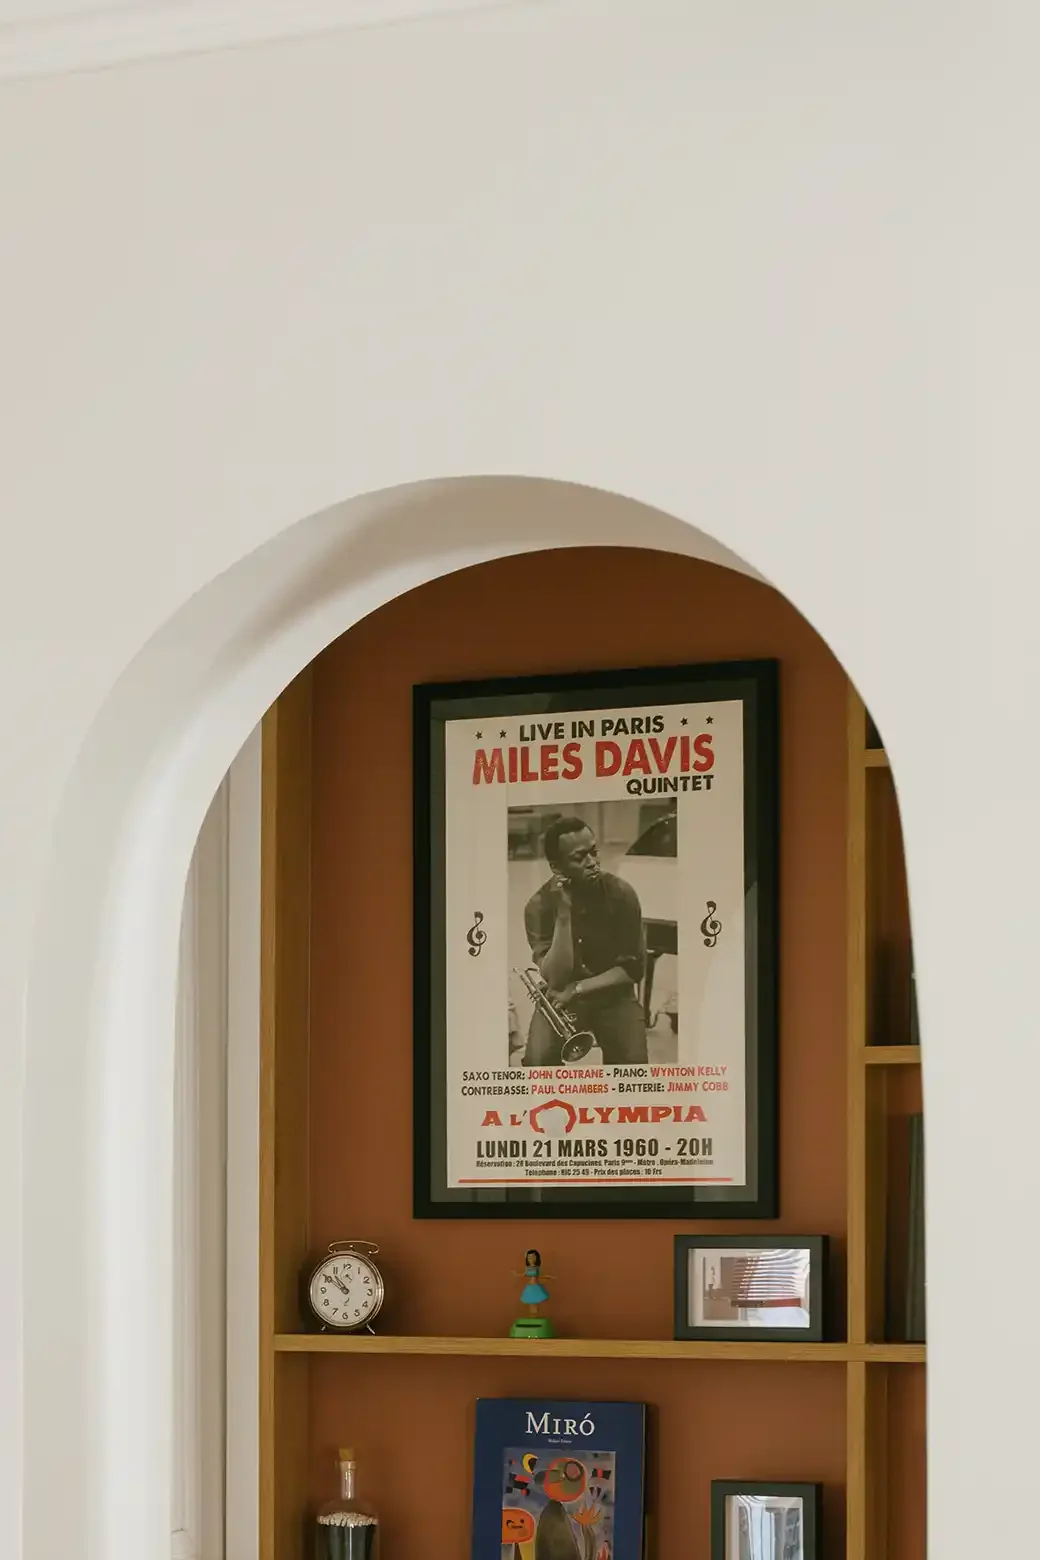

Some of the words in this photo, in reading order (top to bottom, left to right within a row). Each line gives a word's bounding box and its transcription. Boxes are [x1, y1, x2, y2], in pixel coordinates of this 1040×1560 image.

[519, 722, 564, 742] LIVE
[572, 720, 594, 739] IN
[602, 715, 665, 737] PARIS
[472, 742, 583, 785] MILES
[595, 734, 715, 777] DAVIS
[626, 775, 714, 795] QUINTET
[462, 1071, 490, 1081] SAXO
[492, 1071, 525, 1081] TENOR:
[528, 1070, 553, 1079] JOHN
[555, 1069, 604, 1079] COLTRANE
[613, 1068, 648, 1078] PIANO:
[650, 1067, 695, 1078] WYNTON
[697, 1066, 727, 1076] KELLY
[461, 1085, 529, 1096] CONTREBASSE:
[531, 1085, 556, 1095] PAUL
[558, 1084, 609, 1094] CHAMBERS
[618, 1083, 665, 1093] BATTERIE:
[667, 1082, 699, 1092] JIMMY
[702, 1081, 729, 1091] COBB
[480, 1110, 503, 1126] A
[476, 1140, 527, 1158] LUNDI
[533, 1140, 552, 1158] 21
[558, 1139, 608, 1157] MARS
[613, 1138, 659, 1156] 1960
[677, 1138, 712, 1156] 20H
